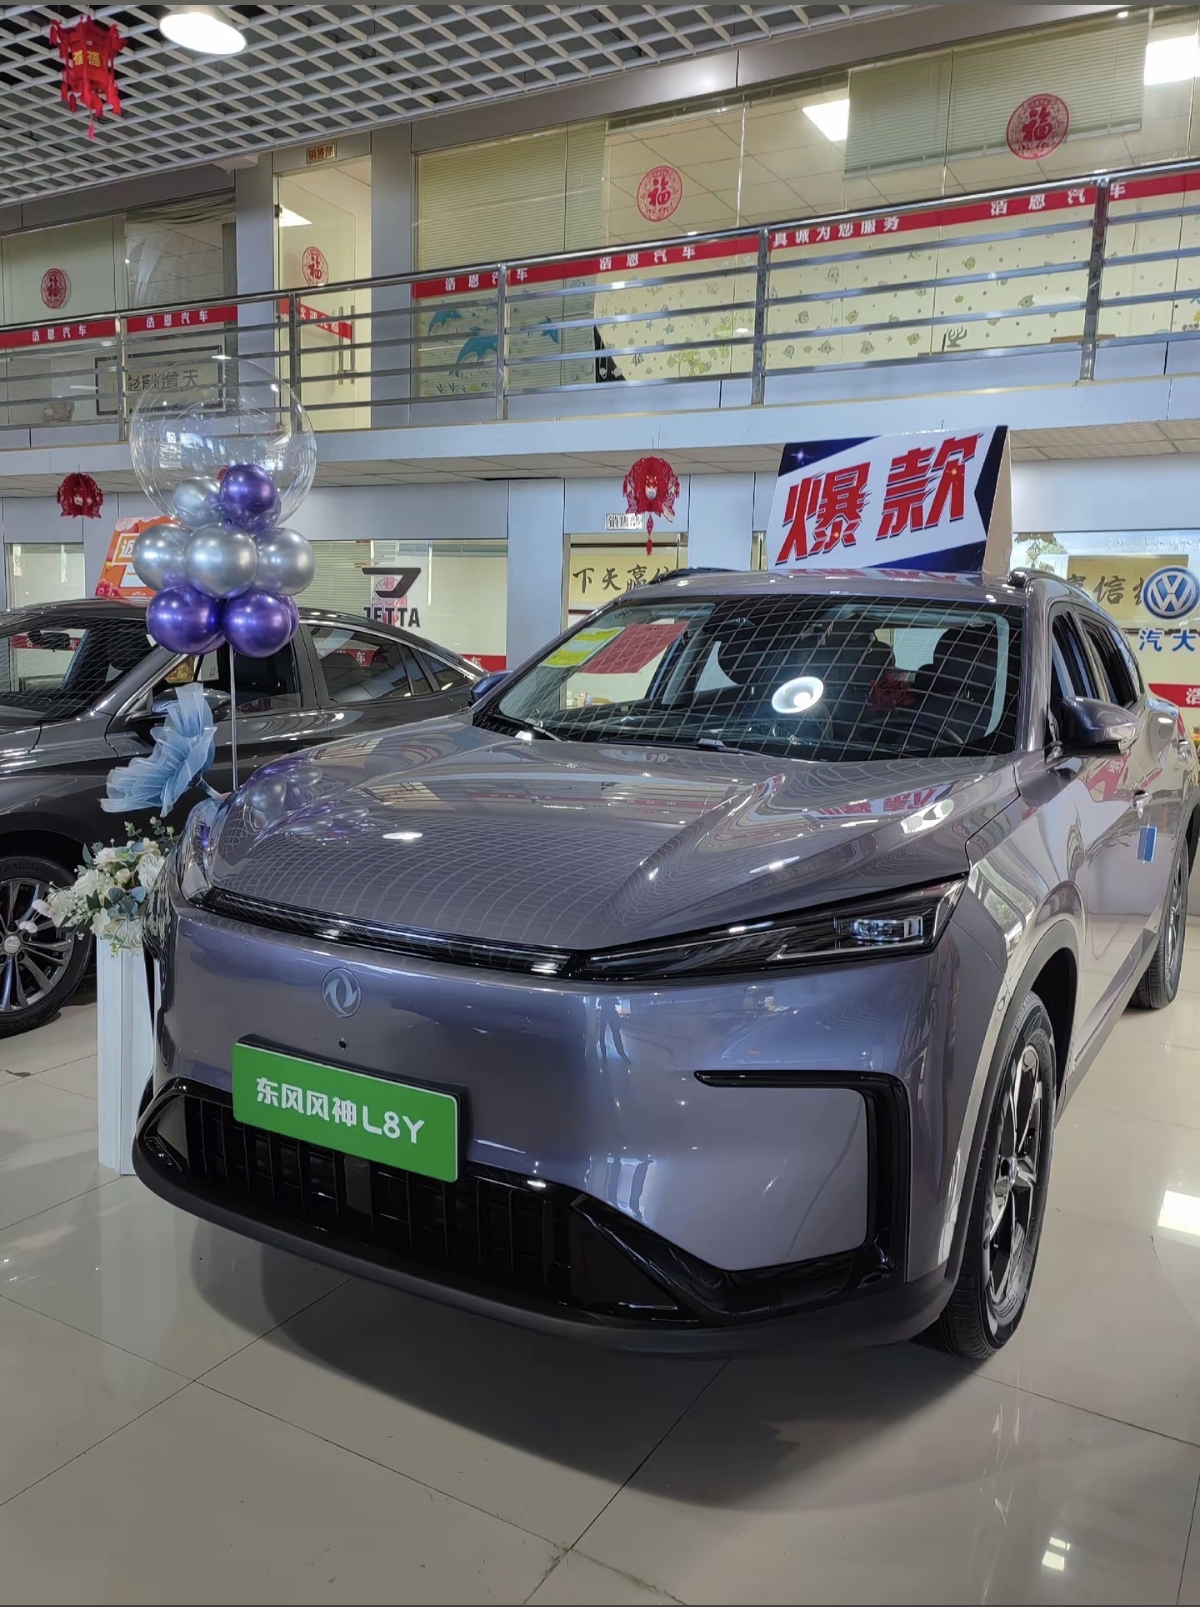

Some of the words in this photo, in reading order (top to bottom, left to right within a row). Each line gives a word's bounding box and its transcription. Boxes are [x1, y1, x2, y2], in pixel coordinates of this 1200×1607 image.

[773, 216, 899, 248] 真诚为您服务
[776, 433, 983, 566] 爆款
